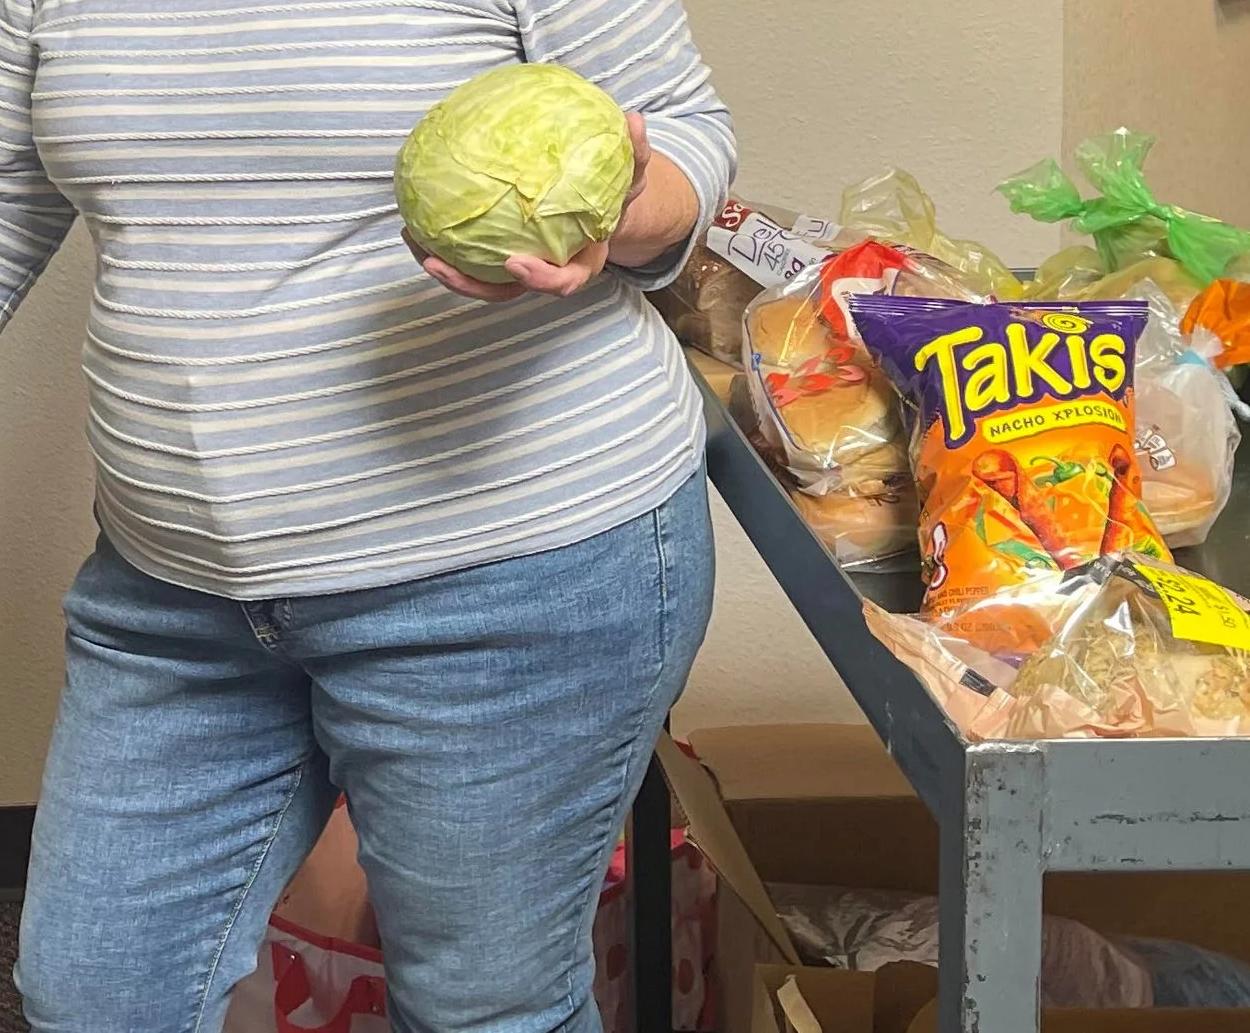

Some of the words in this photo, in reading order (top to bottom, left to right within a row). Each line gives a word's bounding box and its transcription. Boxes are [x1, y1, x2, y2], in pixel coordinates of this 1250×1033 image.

[763, 242, 785, 272] 45
[915, 314, 1126, 440] Takis
[989, 413, 1047, 437] NACHO
[1052, 404, 1123, 427] XPLOSION
